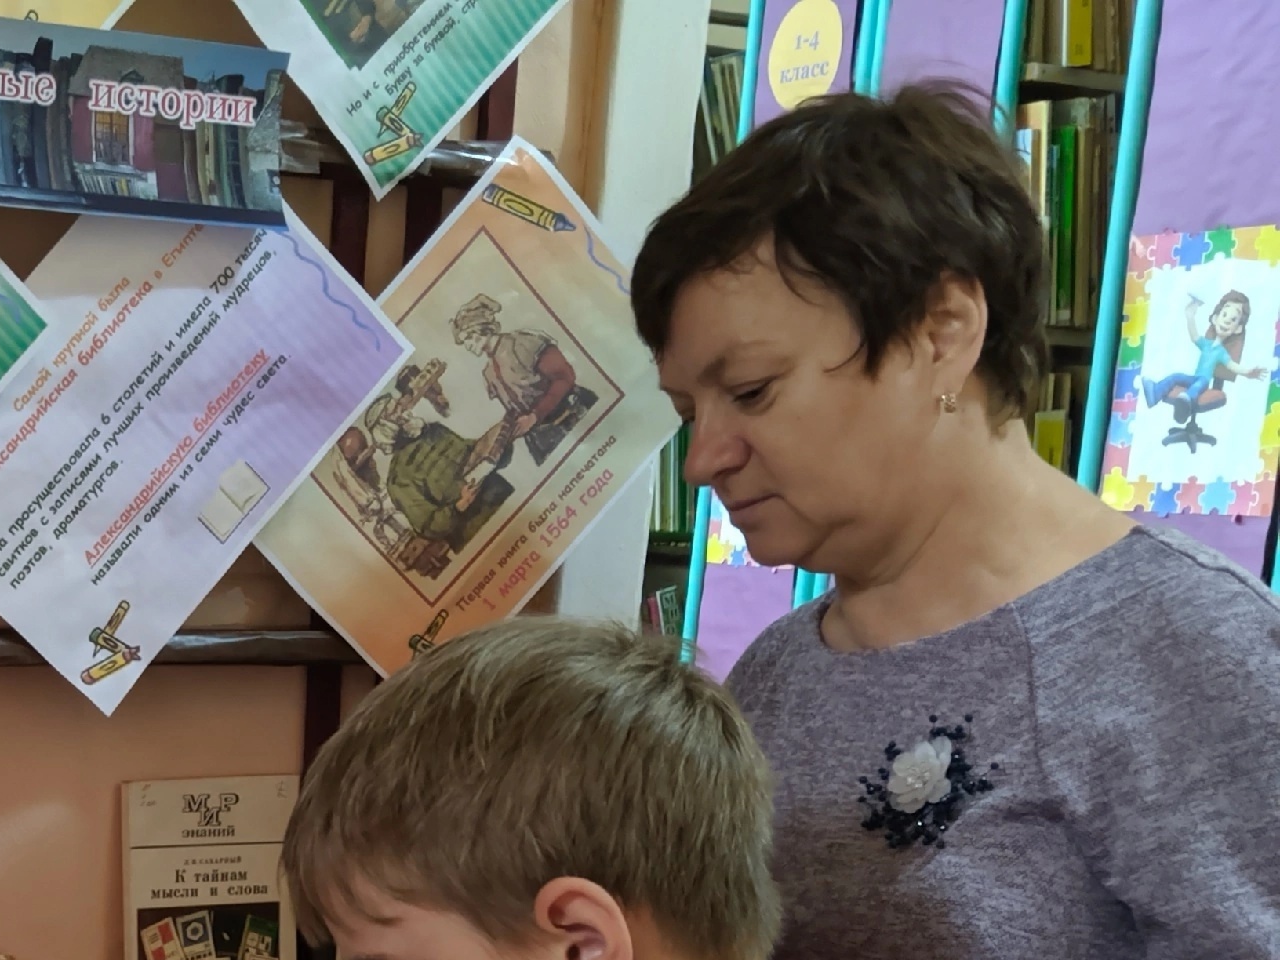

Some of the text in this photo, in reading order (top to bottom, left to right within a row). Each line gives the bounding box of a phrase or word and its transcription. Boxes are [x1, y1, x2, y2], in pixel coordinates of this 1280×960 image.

[90, 81, 255, 127] истории
[346, 99, 362, 117] Но
[363, 91, 372, 100] и
[383, 3, 453, 77] приобретением
[384, 66, 413, 96] Букву
[780, 61, 829, 84] класс
[795, 31, 819, 51] 1-4
[13, 277, 131, 412] Самой крупной была
[77, 280, 154, 366] библиотека
[154, 270, 163, 280] в
[161, 223, 205, 268] Египте
[8, 426, 101, 537] просуществовала
[101, 412, 111, 426] 6
[112, 352, 164, 413] столетий
[165, 340, 176, 352] и
[175, 295, 212, 340] имела
[209, 266, 236, 294] 700
[234, 228, 268, 268] тысяч
[40, 515, 50, 527] с
[51, 453, 103, 516] записями
[103, 401, 145, 454] лучших
[144, 311, 222, 402] произведений
[222, 249, 277, 313] мудрецов,
[83, 348, 269, 567] Александрийскую библиотеку
[90, 353, 292, 586] называли одним из семи чудес света.
[456, 434, 617, 612] Первая книга была напечатана
[9, 459, 124, 590] поэтов, драматургов.
[482, 468, 614, 612] 1 марта 1564 года
[151, 884, 268, 899] мысли и слова
[175, 869, 248, 883] К тайнам
[181, 825, 235, 838] знаний
